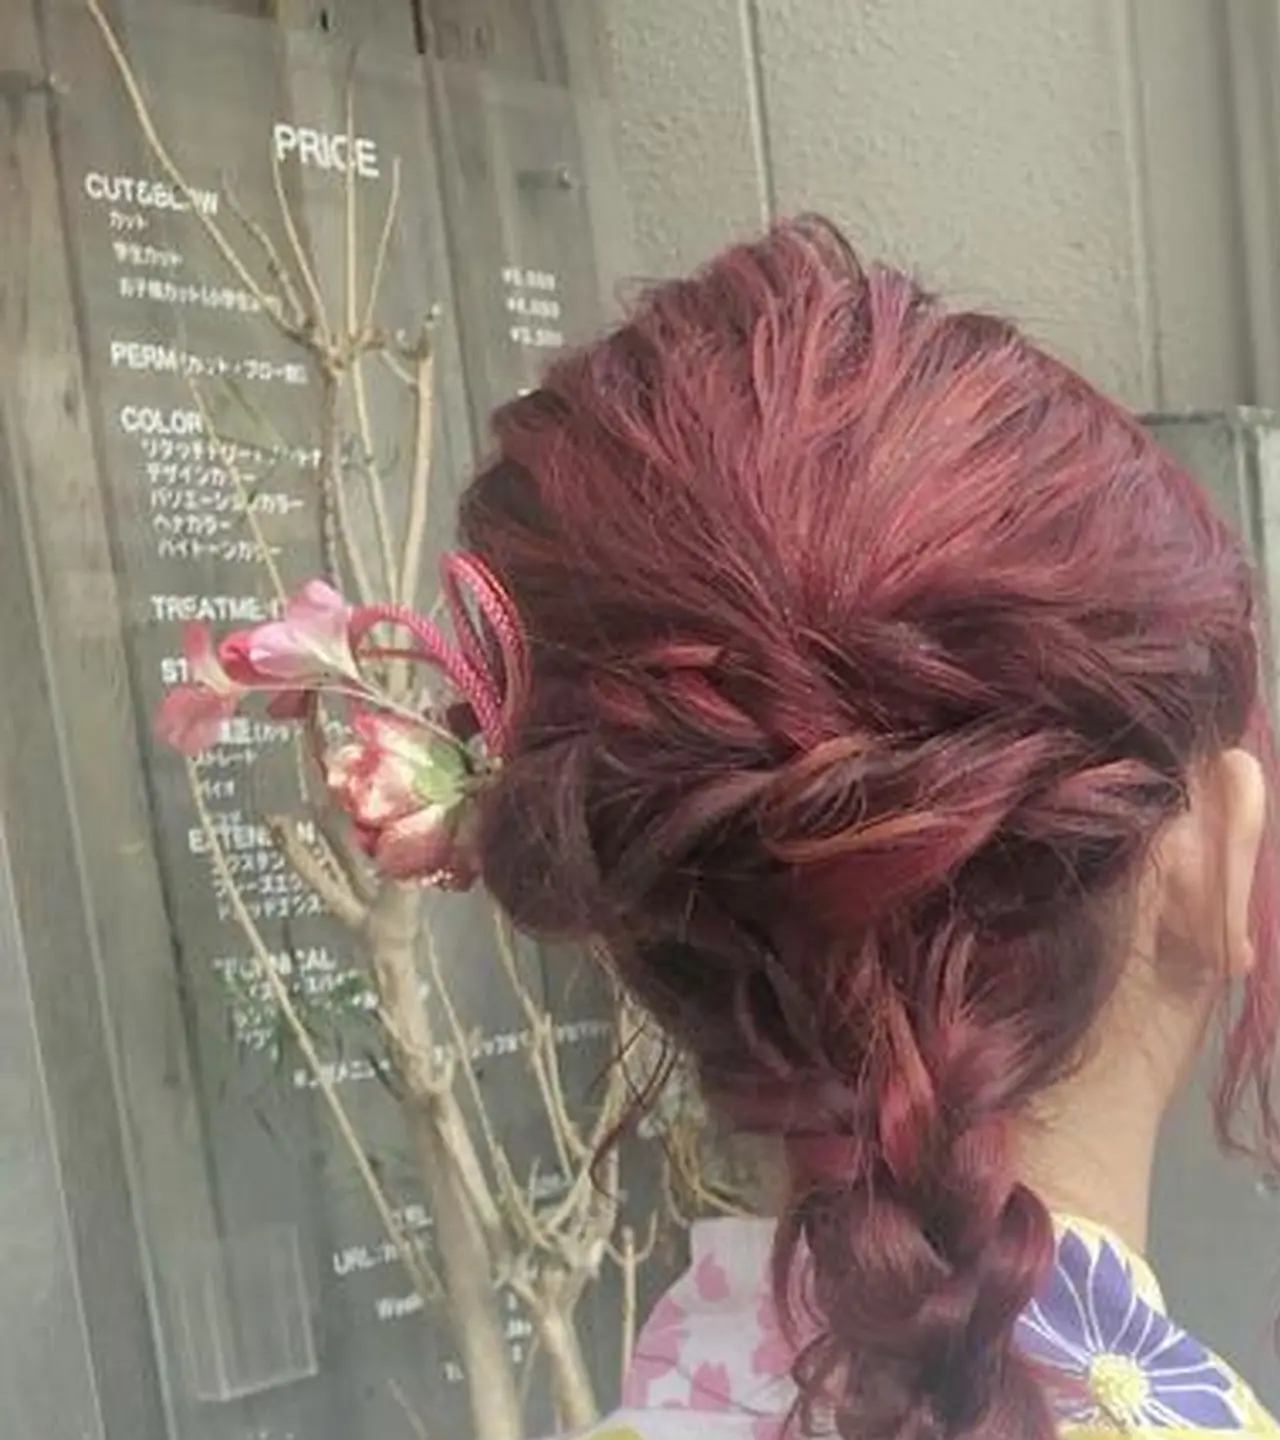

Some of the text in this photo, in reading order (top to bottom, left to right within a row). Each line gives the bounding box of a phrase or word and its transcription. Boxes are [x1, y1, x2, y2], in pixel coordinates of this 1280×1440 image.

[273, 124, 379, 178] PRICE
[85, 172, 219, 215] CUT&BLW
[110, 341, 177, 374] PERM
[120, 405, 203, 435] COLOR
